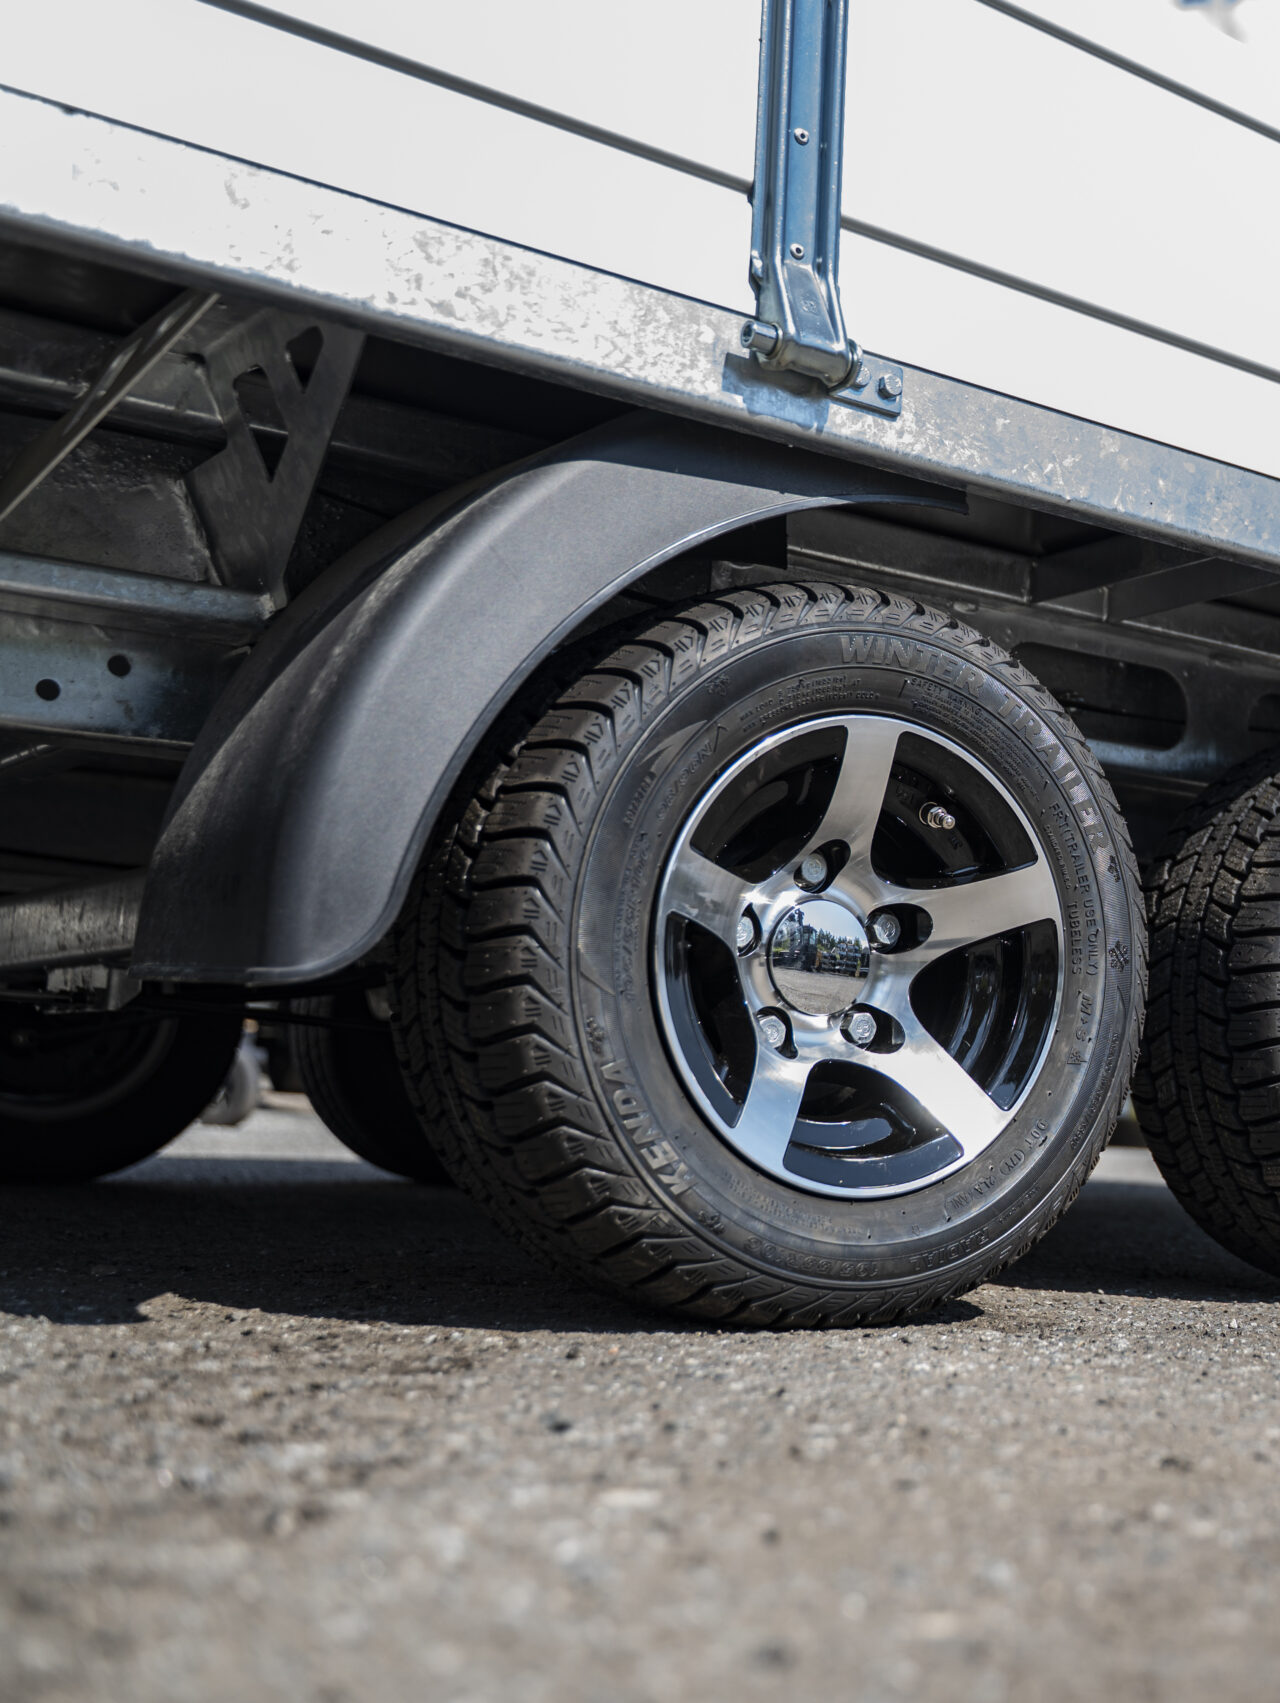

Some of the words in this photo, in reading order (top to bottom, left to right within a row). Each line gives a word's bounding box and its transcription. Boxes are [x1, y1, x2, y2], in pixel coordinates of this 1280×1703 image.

[910, 676, 944, 696] SAFETY
[840, 634, 986, 698] WINTER
[998, 692, 1110, 854] TRAILER
[1082, 897, 1097, 927] USE
[1066, 900, 1082, 975] TUBELESS
[1085, 932, 1098, 976] ONLY)
[600, 1059, 698, 1196] KENDA
[1022, 1115, 1050, 1150] DOT
[909, 1227, 990, 1270] RADIAL
